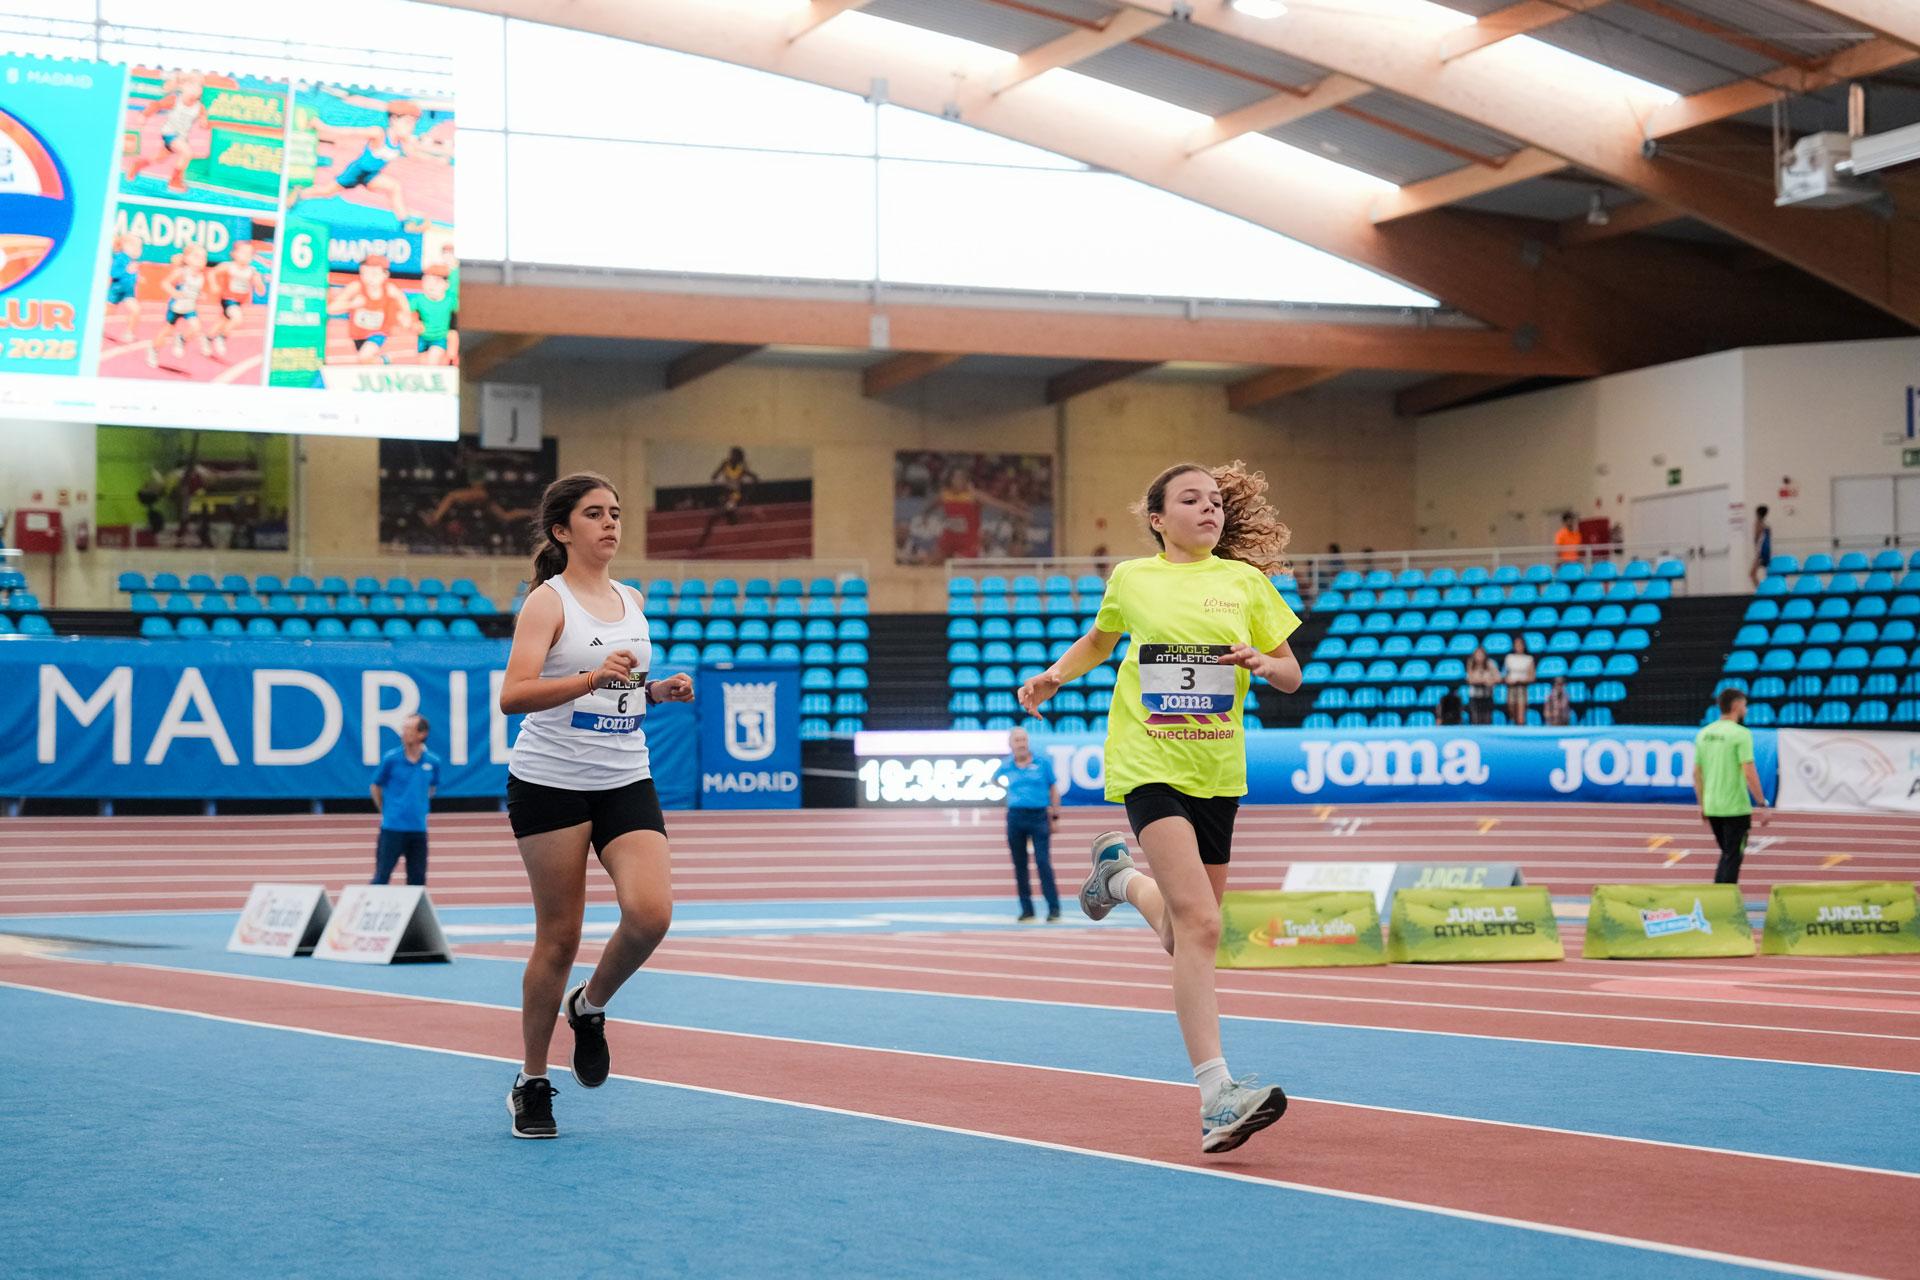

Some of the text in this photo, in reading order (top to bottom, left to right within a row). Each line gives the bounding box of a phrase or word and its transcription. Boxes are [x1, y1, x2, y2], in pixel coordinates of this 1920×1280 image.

[290, 233, 313, 269] 6
[351, 372, 447, 394] JUNGLE
[1155, 654, 1219, 664] ATHLETICS
[1164, 645, 1210, 655] JUNGLE
[1180, 667, 1196, 690] 3
[617, 692, 629, 714] 6
[38, 664, 513, 766] MADRI
[1291, 737, 1489, 794] Joma
[1549, 737, 1696, 794] Jom
[702, 771, 799, 793] MADRID
[1415, 867, 1488, 889] JUNGLE
[1446, 906, 1518, 923] JUNGLE
[1816, 905, 1882, 922] JUNGLE
[1434, 921, 1536, 938] ATHLETICS
[1806, 920, 1900, 936] ATHLETICS
